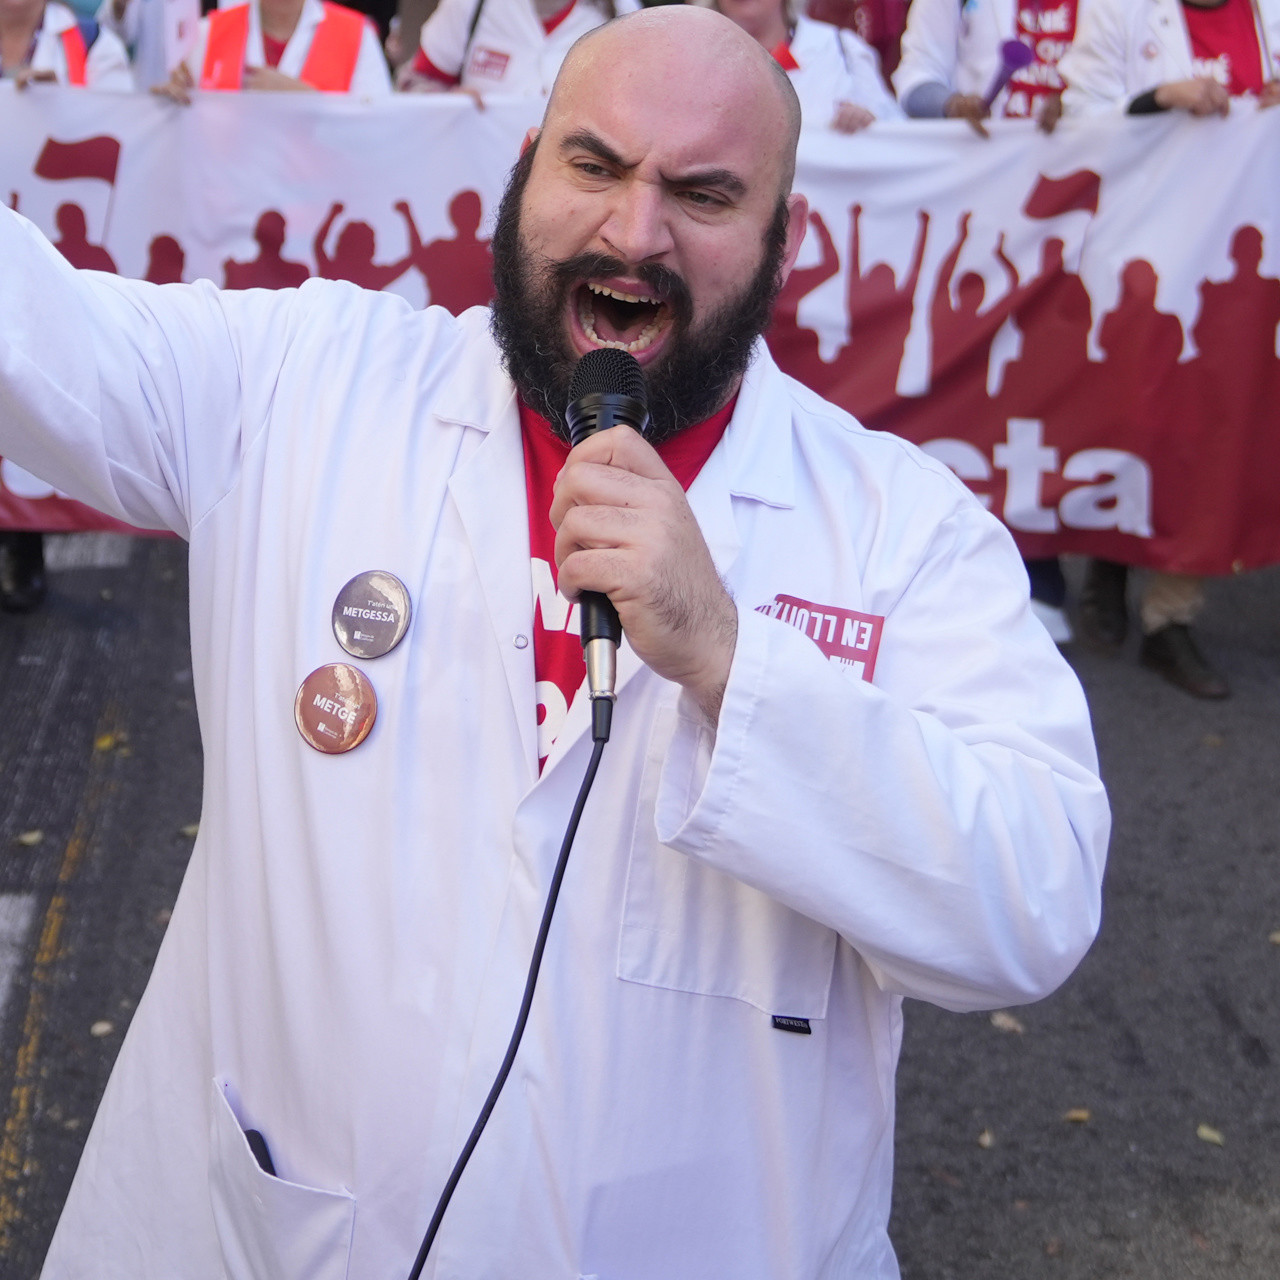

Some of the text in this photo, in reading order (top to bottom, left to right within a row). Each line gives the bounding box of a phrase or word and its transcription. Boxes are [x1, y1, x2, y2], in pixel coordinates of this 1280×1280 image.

[342, 606, 395, 623] METGESSA
[840, 618, 873, 651] EN
[312, 694, 357, 725] METGE
